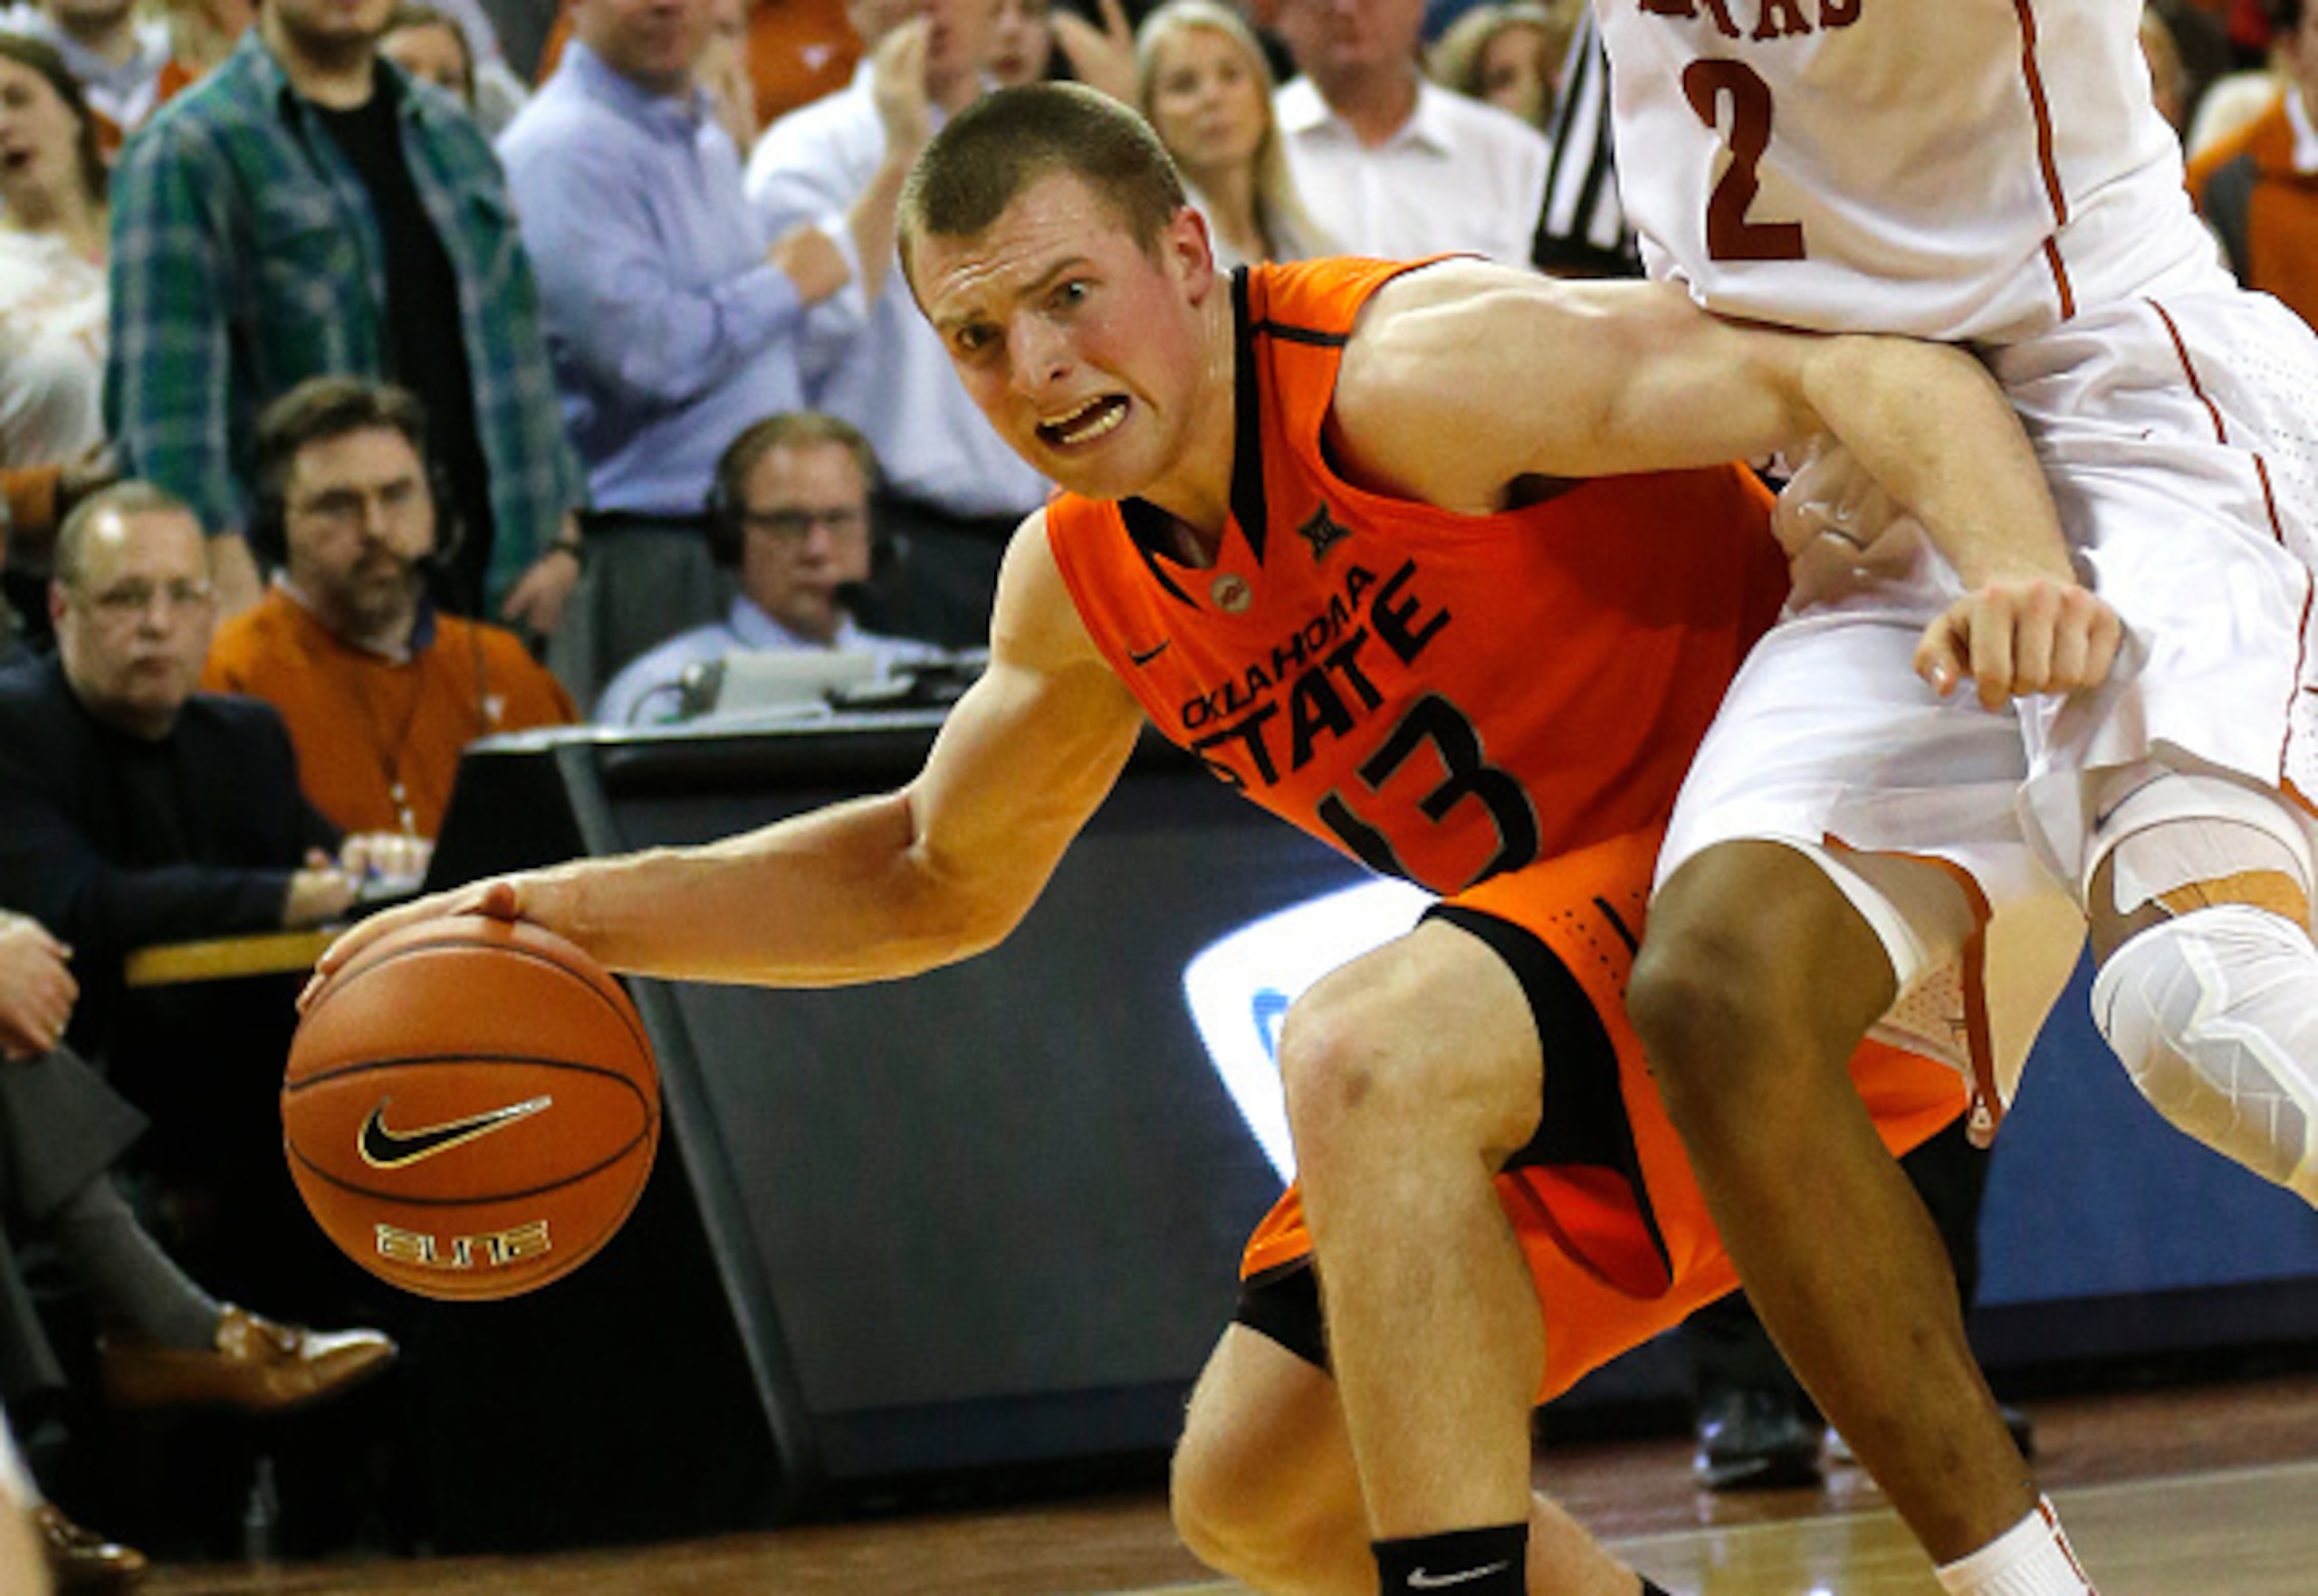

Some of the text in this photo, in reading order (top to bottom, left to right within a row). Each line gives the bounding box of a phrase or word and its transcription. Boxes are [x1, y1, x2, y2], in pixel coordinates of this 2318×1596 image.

[1681, 58, 1806, 260] 2
[1182, 566, 1376, 729] OKLAHOMA
[1317, 693, 1539, 894] 13
[375, 1220, 551, 1267] ELITE
